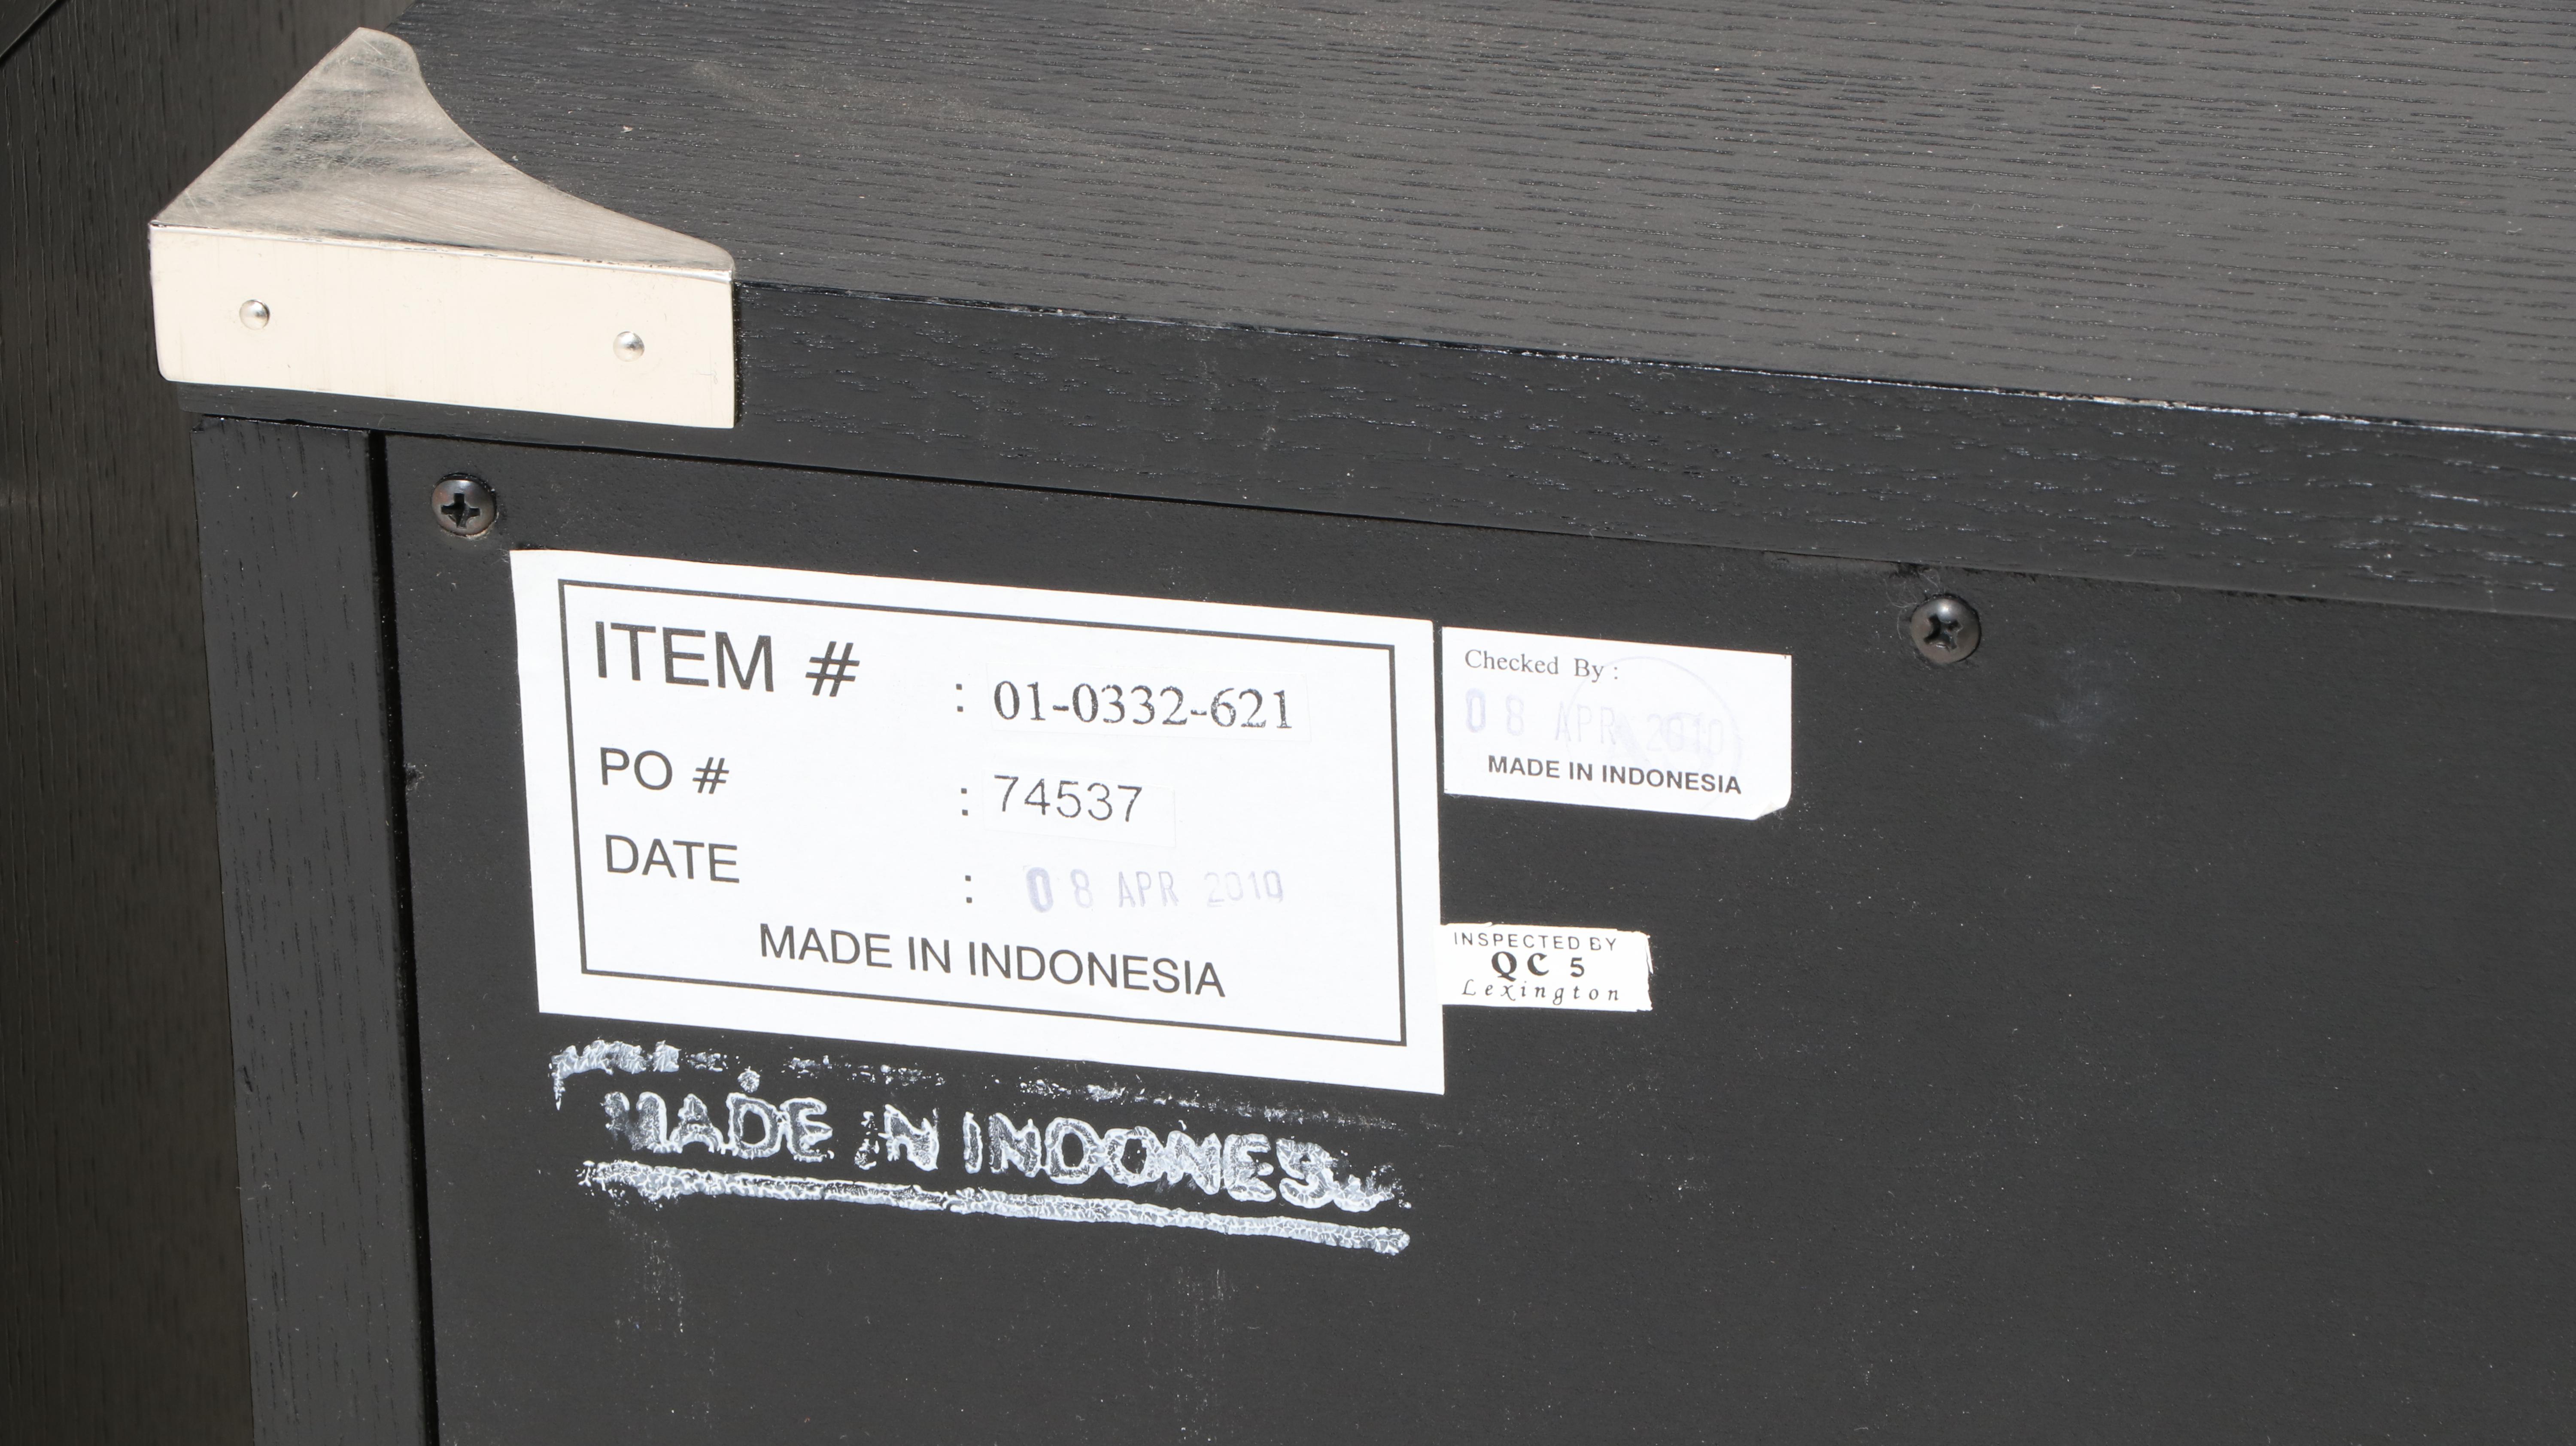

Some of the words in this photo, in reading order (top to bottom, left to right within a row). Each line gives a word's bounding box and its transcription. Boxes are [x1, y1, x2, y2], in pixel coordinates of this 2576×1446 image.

[595, 621, 774, 692] ITEM
[805, 641, 860, 697] #
[993, 680, 1290, 729] 01-0332-621
[1464, 650, 1559, 675] Checked
[1554, 701, 1617, 746] APR
[600, 747, 673, 791] PO
[692, 757, 729, 794] #
[994, 775, 1142, 822] 74537
[1488, 755, 1559, 779] MADE
[1569, 762, 1593, 781] IN
[1602, 765, 1742, 795] INDONESIA
[605, 834, 740, 884] DATE
[1118, 871, 1180, 907] APR
[1203, 869, 1284, 907] 2010
[760, 923, 892, 968] MADE
[908, 936, 951, 973] IN
[969, 942, 1225, 997] INDONESIA
[1454, 932, 1580, 950] INSPECTED
[1589, 936, 1616, 951] BY
[1570, 957, 1585, 978] 5
[1462, 979, 1619, 1006] Lexington
